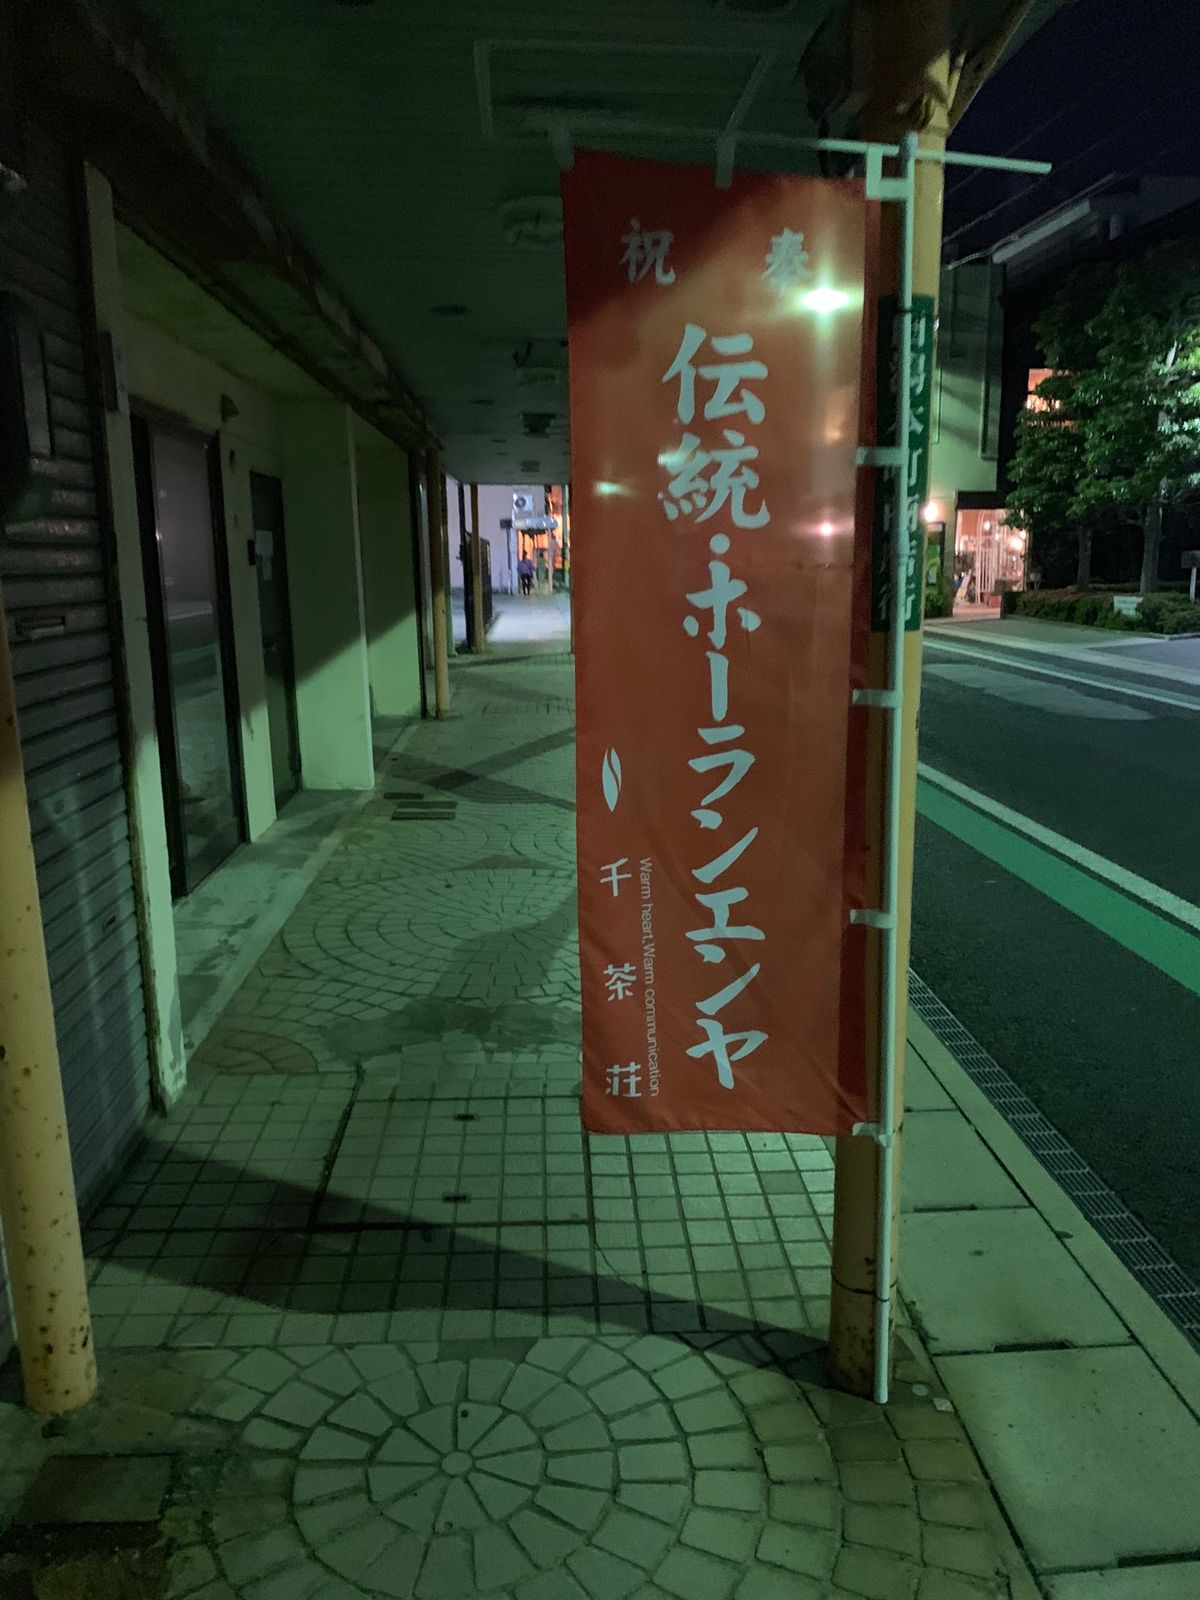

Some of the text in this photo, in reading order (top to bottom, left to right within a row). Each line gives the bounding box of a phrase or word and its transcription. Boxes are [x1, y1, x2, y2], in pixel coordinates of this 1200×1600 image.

[619, 217, 676, 286] 祝
[639, 857, 653, 900] Warm
[599, 857, 642, 1099] 千茶荘
[644, 988, 661, 1097] communication
